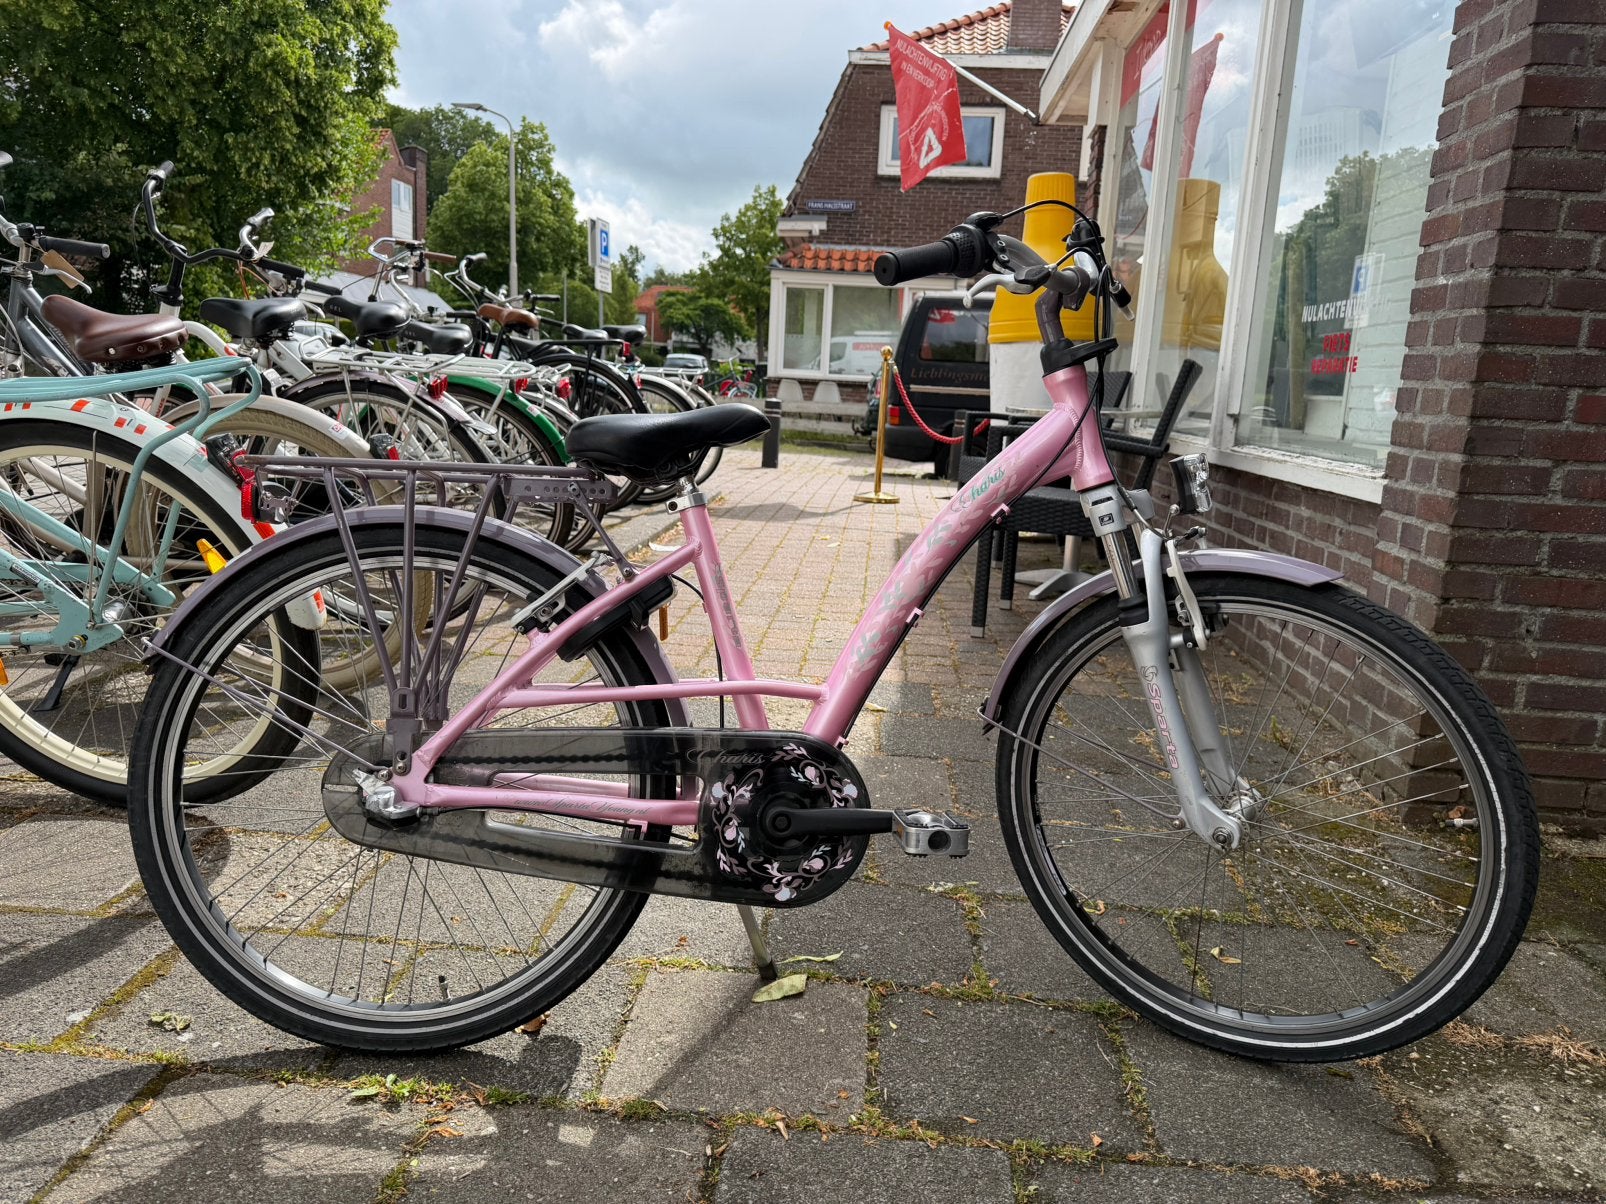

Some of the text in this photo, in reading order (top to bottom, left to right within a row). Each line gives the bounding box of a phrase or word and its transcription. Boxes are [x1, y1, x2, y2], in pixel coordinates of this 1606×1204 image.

[601, 232, 608, 253] P
[1323, 332, 1351, 353] FIETS
[1312, 356, 1358, 375] REPARATIE
[951, 467, 1006, 512] Charis
[1147, 683, 1179, 769] Sparta
[687, 747, 766, 766] Charis
